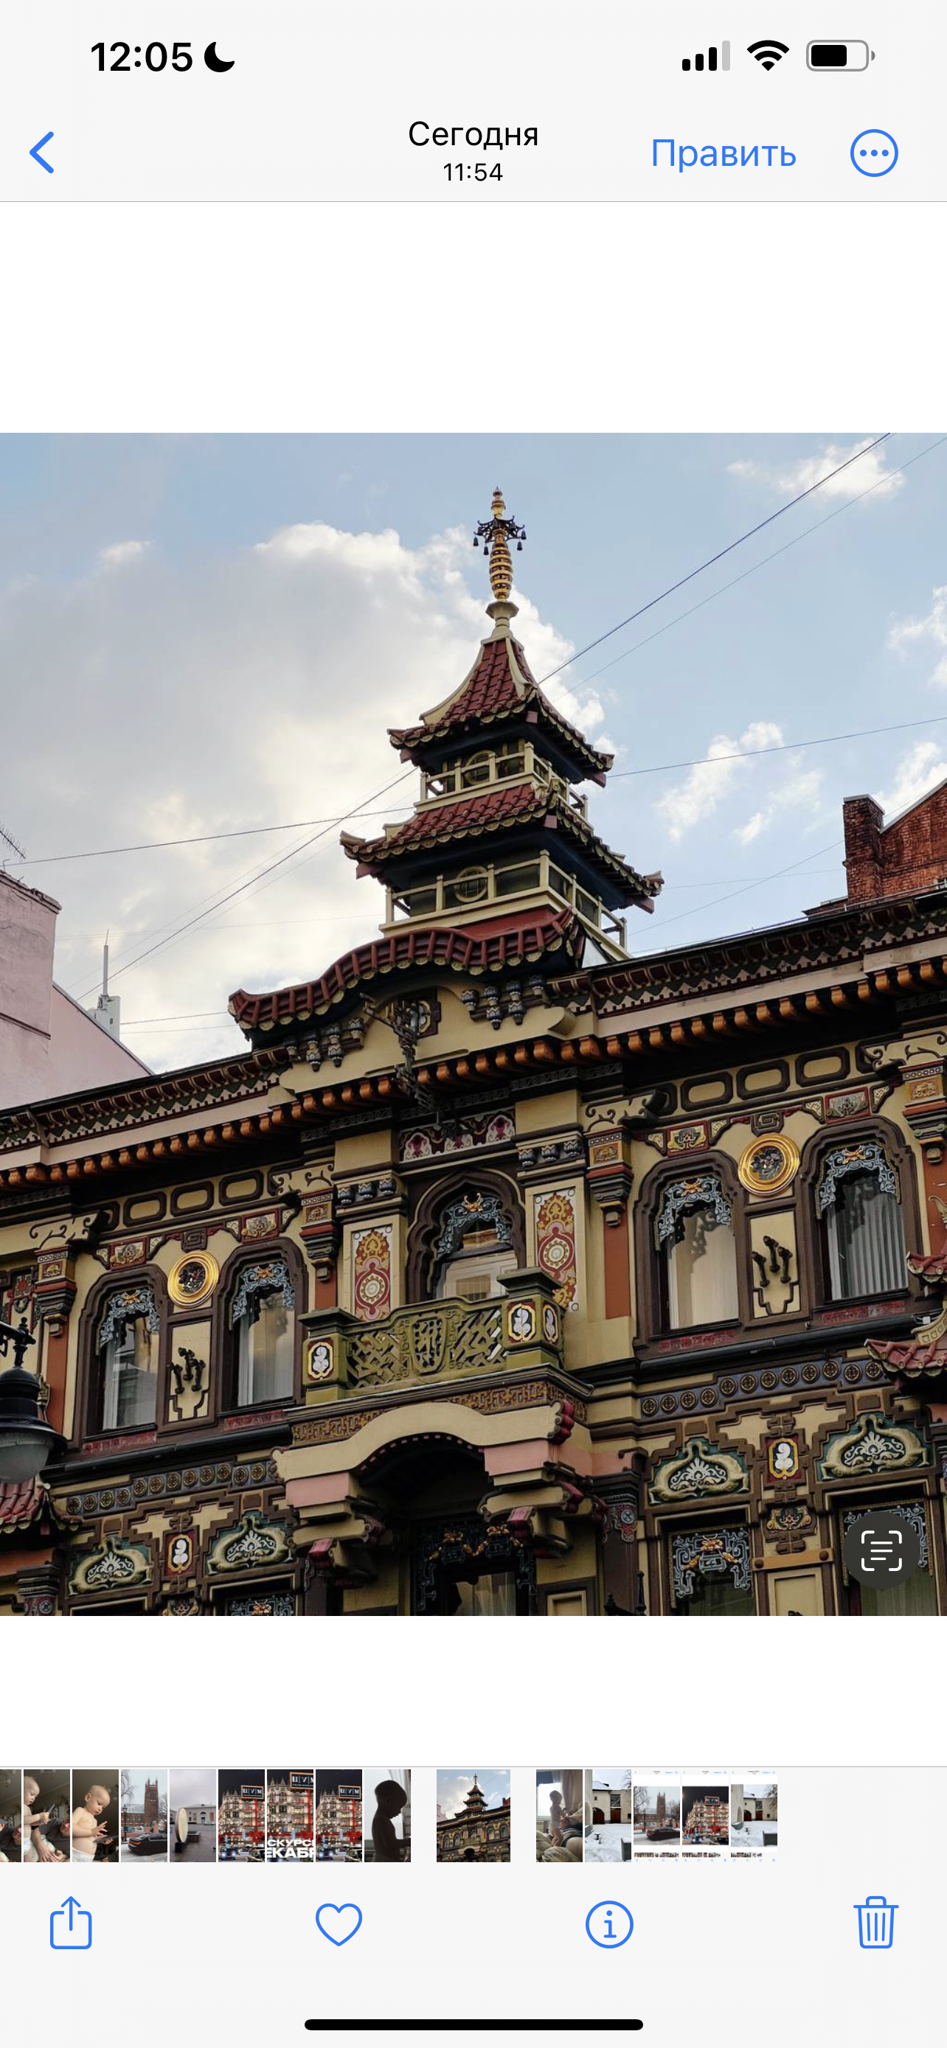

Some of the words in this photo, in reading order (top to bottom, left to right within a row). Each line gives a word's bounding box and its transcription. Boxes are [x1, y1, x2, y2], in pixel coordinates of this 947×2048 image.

[91, 42, 193, 72] 12:05
[409, 121, 538, 150] Сегодня
[652, 139, 797, 173] Править
[443, 163, 504, 182] 11:54
